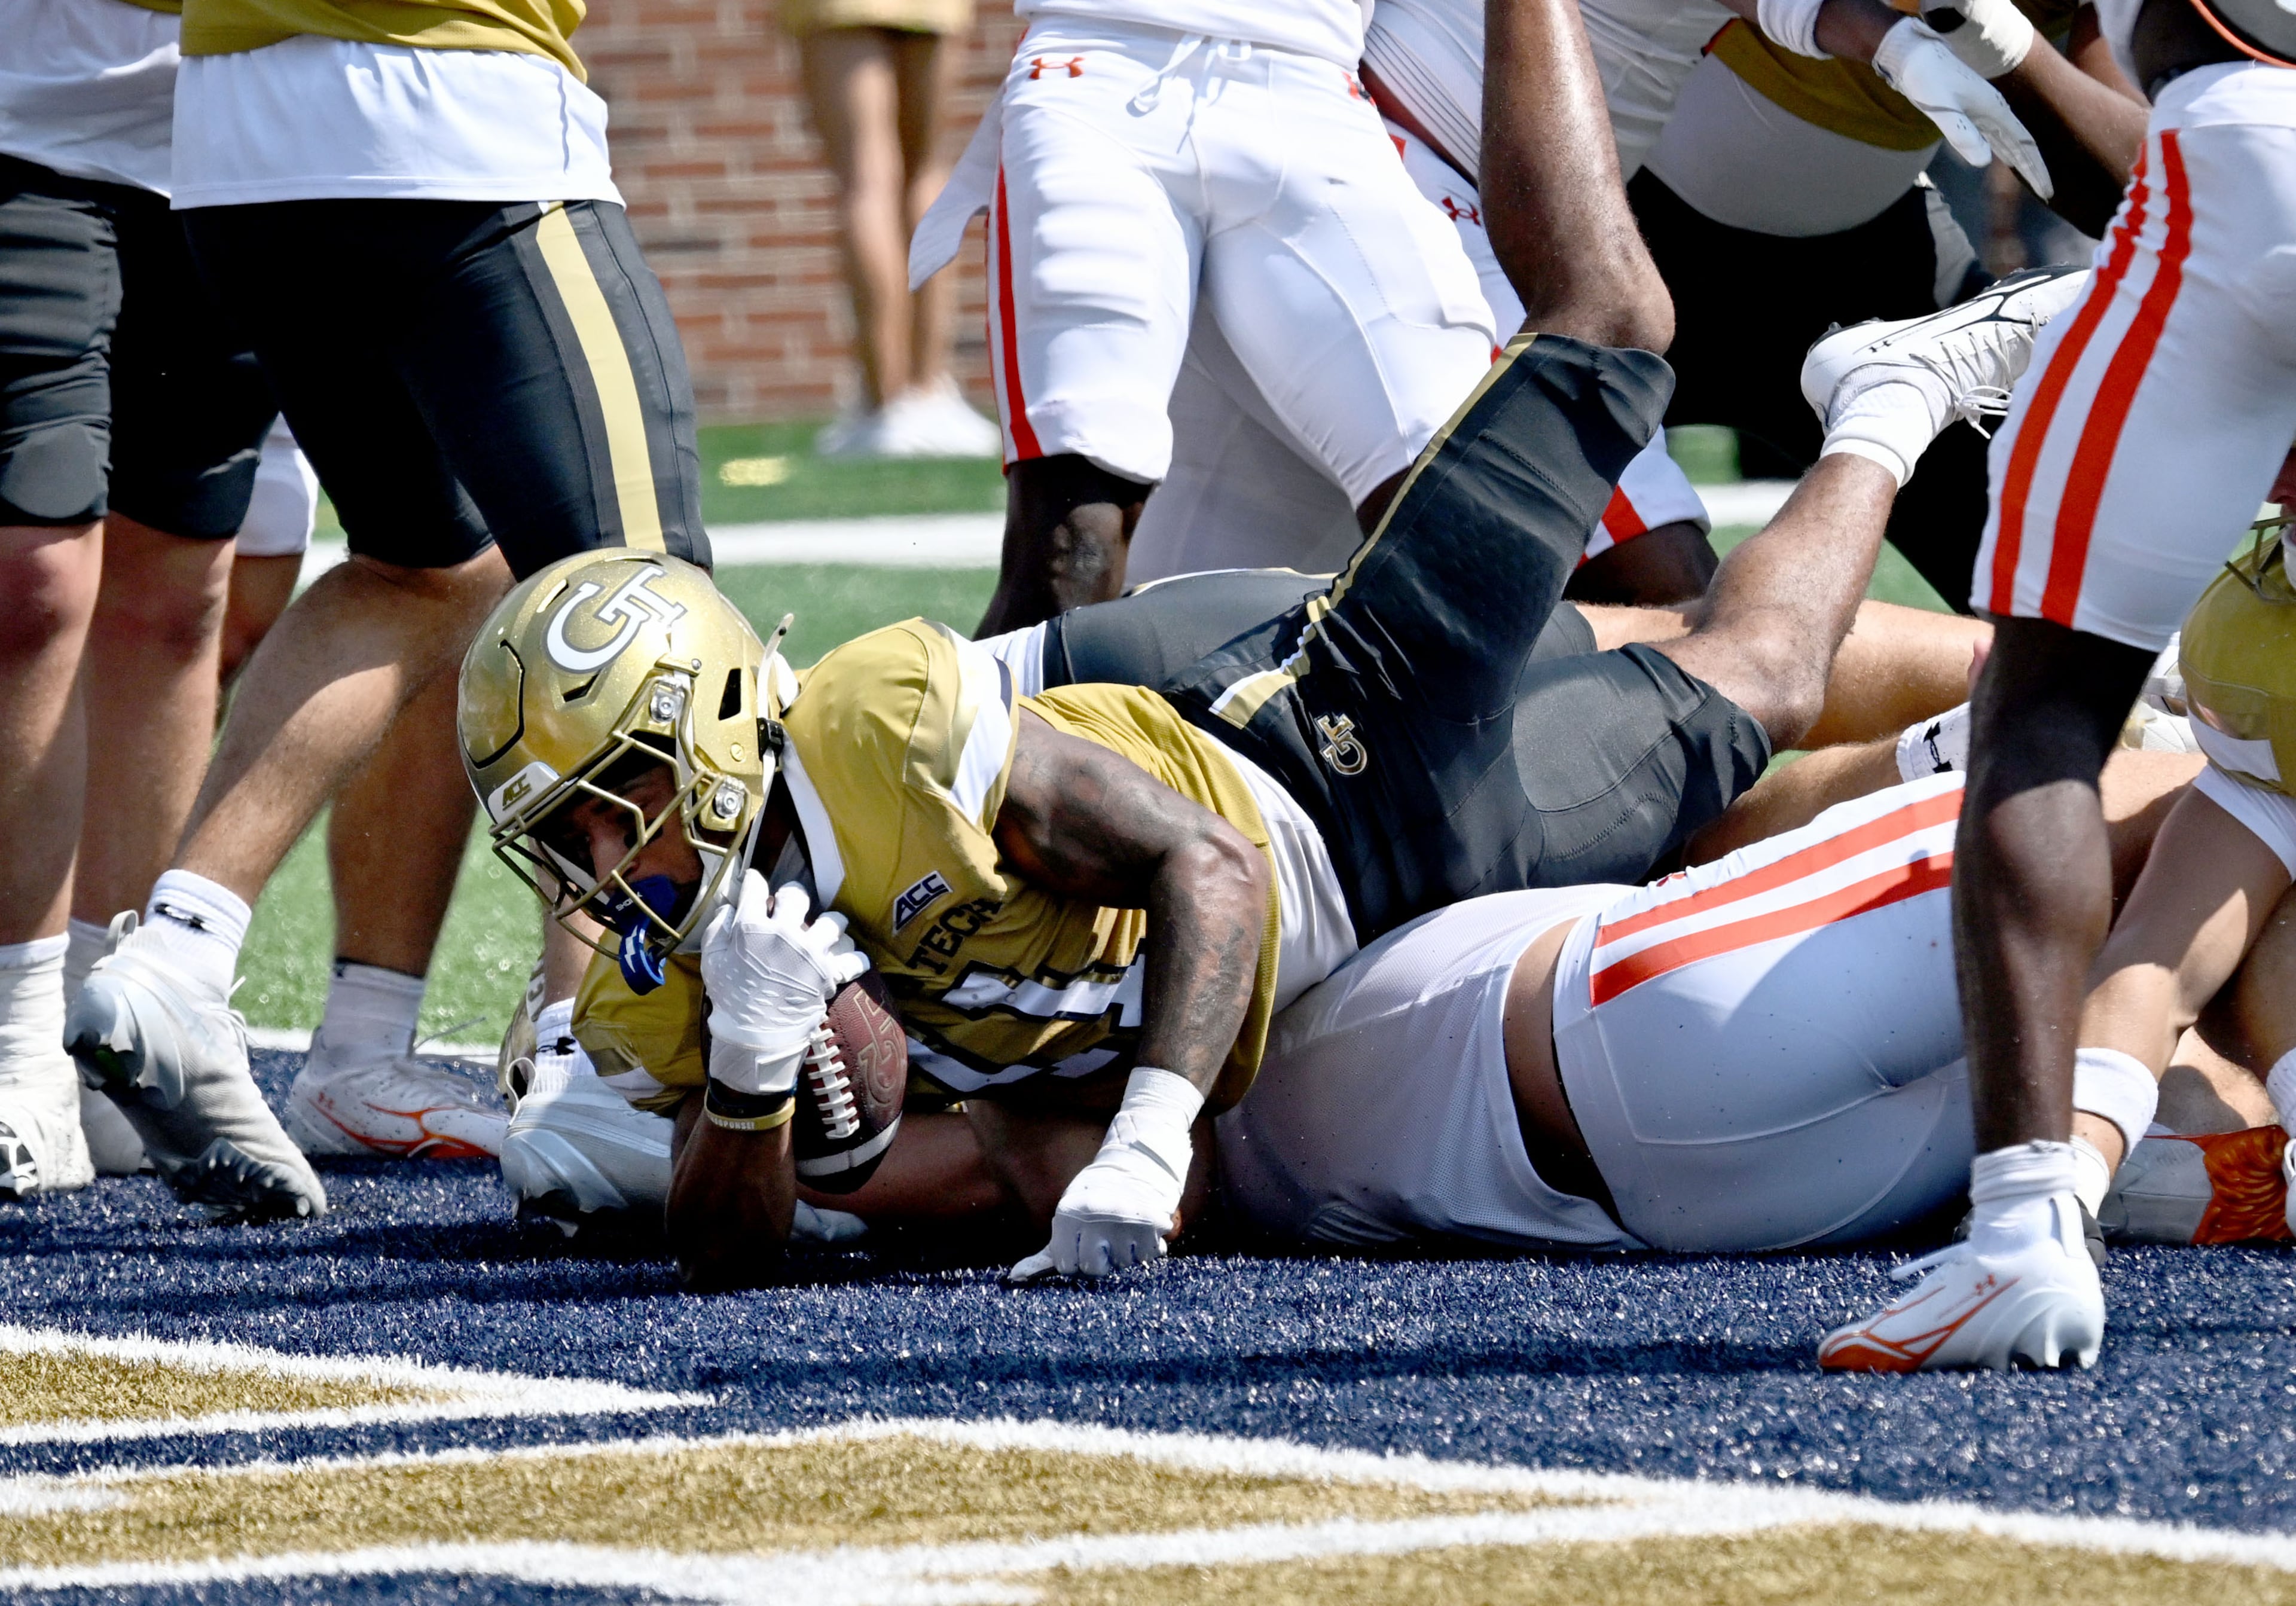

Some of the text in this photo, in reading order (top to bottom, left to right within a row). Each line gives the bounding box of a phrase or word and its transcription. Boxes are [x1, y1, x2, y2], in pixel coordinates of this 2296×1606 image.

[502, 773, 531, 808] ACC
[896, 874, 949, 928] ACC
[905, 899, 1003, 975] TECH
